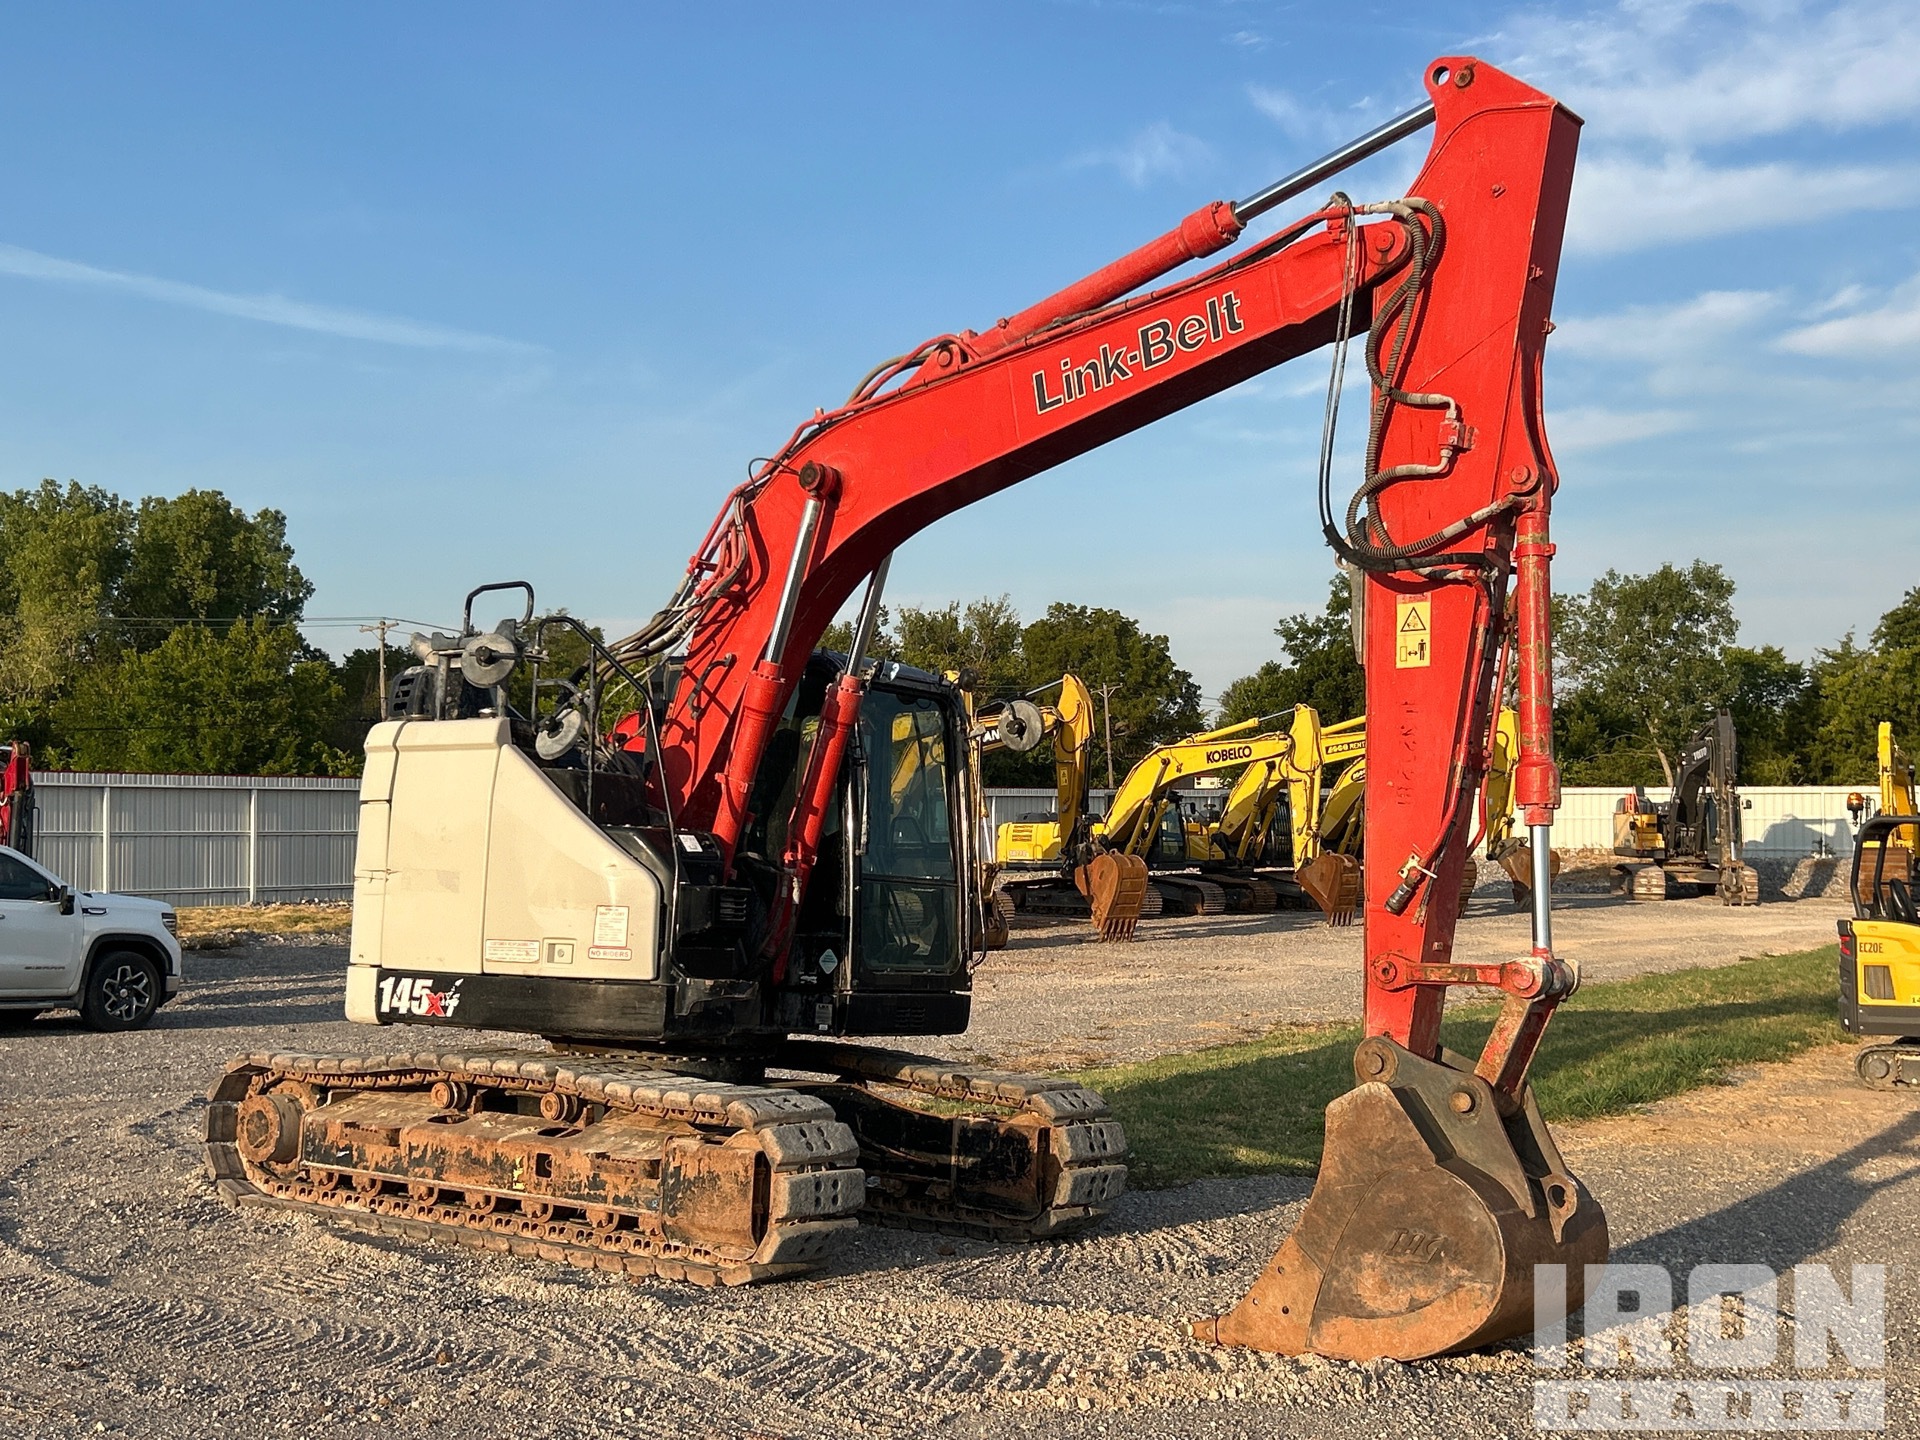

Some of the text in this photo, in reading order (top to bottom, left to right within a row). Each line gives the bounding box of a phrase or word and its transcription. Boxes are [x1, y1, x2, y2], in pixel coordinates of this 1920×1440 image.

[1032, 290, 1245, 415] Link-Belt
[983, 728, 1000, 743] AN
[1206, 745, 1253, 764] KOBELCO
[602, 950, 629, 958] RIDERS
[1859, 942, 1884, 954] EC20E
